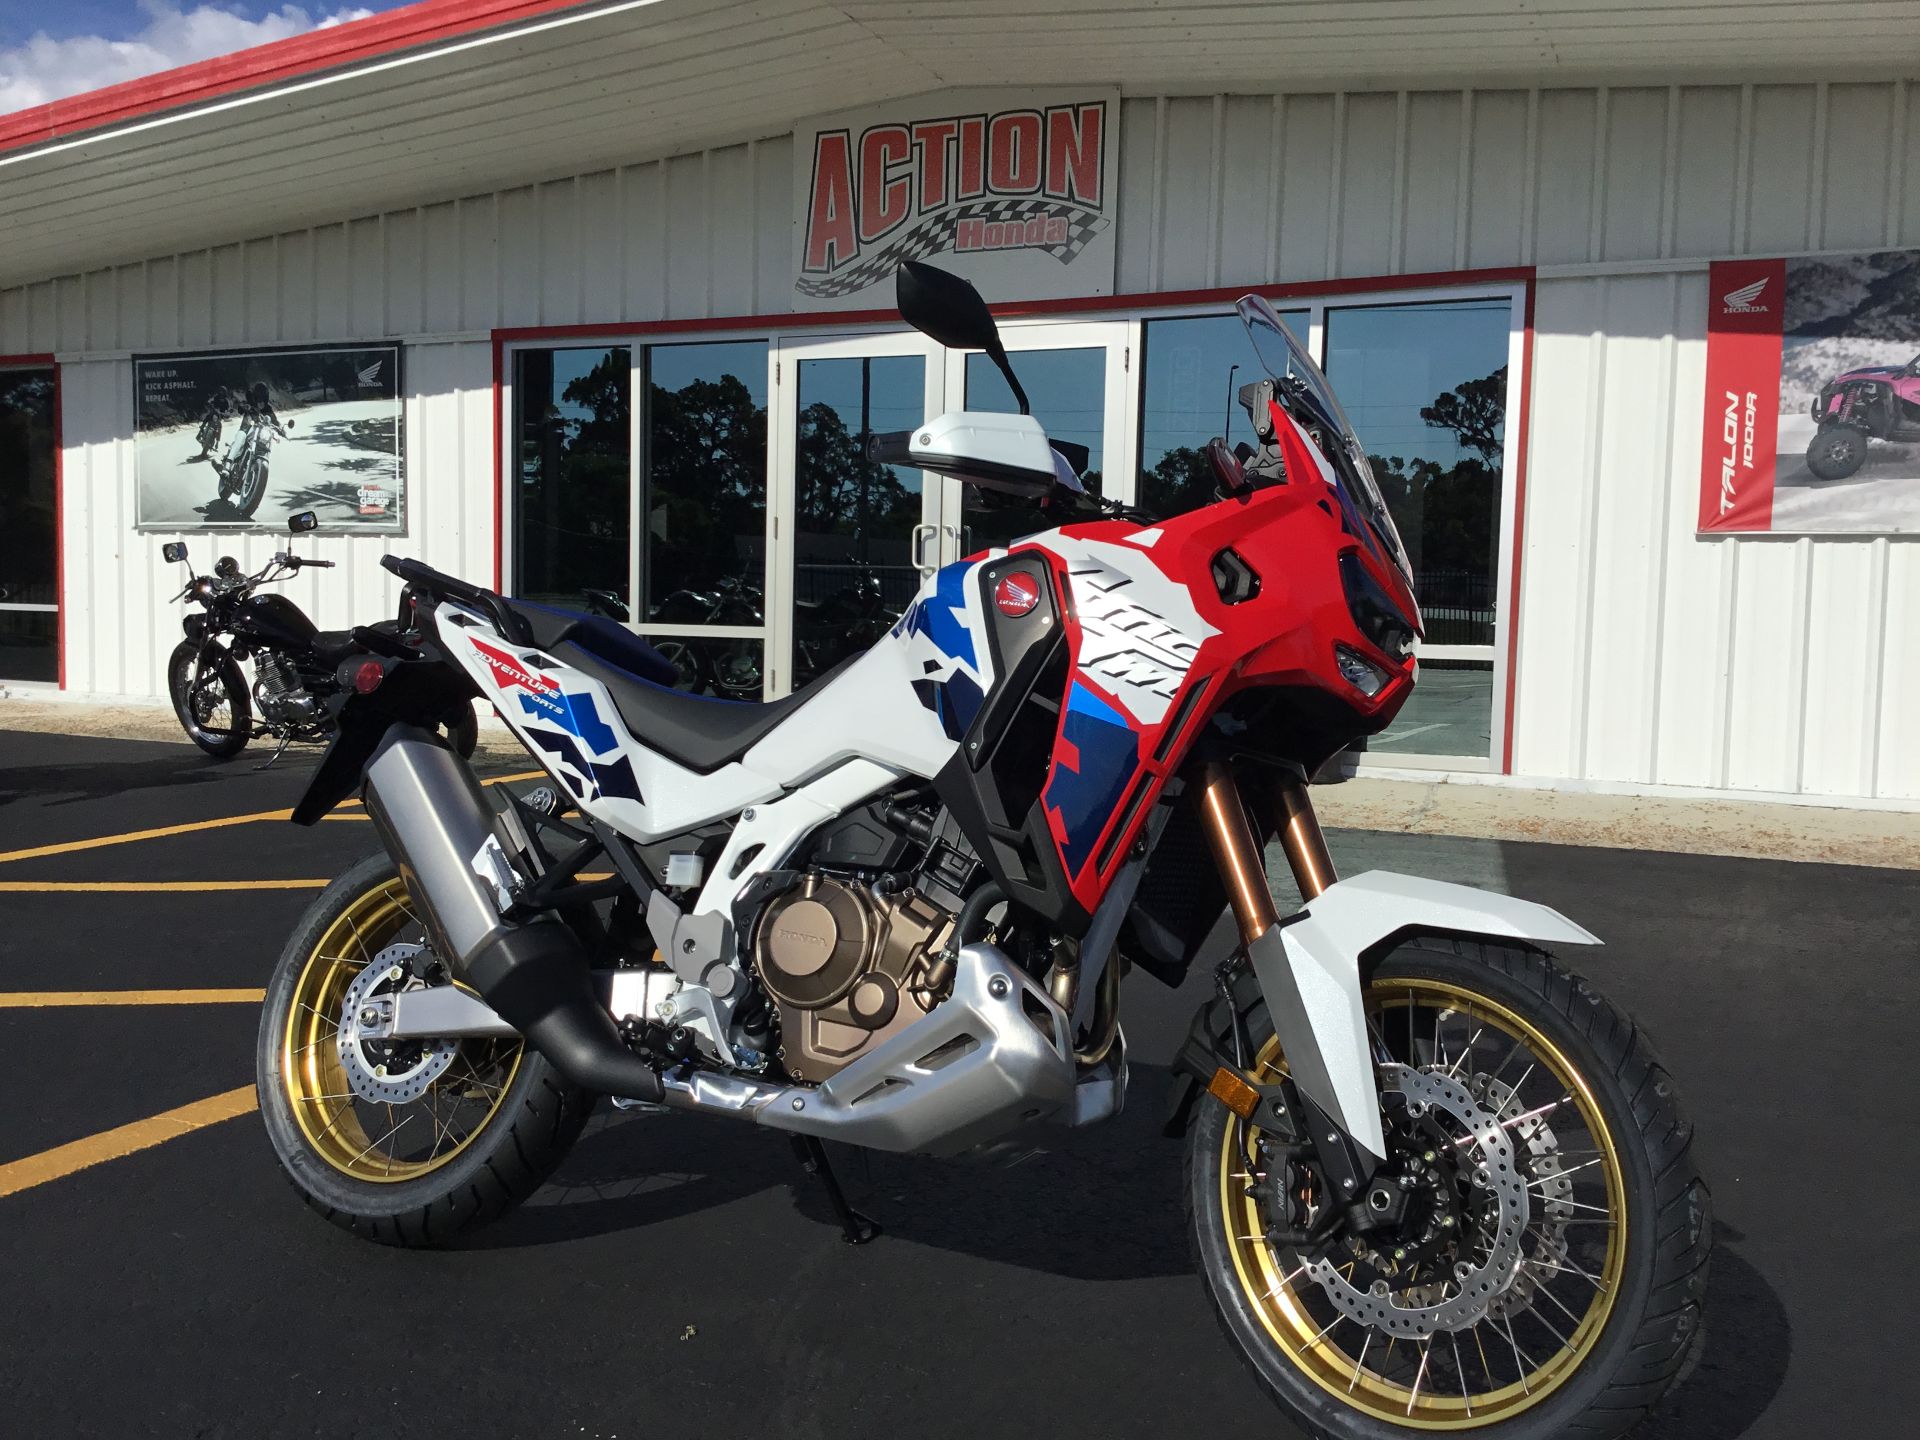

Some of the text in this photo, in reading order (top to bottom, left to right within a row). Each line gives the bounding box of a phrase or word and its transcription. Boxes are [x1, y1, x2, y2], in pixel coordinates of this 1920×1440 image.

[802, 100, 1106, 273] ACTION
[954, 211, 1069, 252] Honda
[1723, 305, 1769, 313] HONDA
[145, 370, 165, 378] WAKE
[1743, 392, 1757, 469] 1000R
[1721, 391, 1739, 515] TALON
[357, 486, 385, 498] dream
[360, 497, 390, 507] garage
[473, 650, 561, 700] ADVENTURE
[516, 687, 565, 715] SPORTS
[779, 928, 828, 947] HONDA
